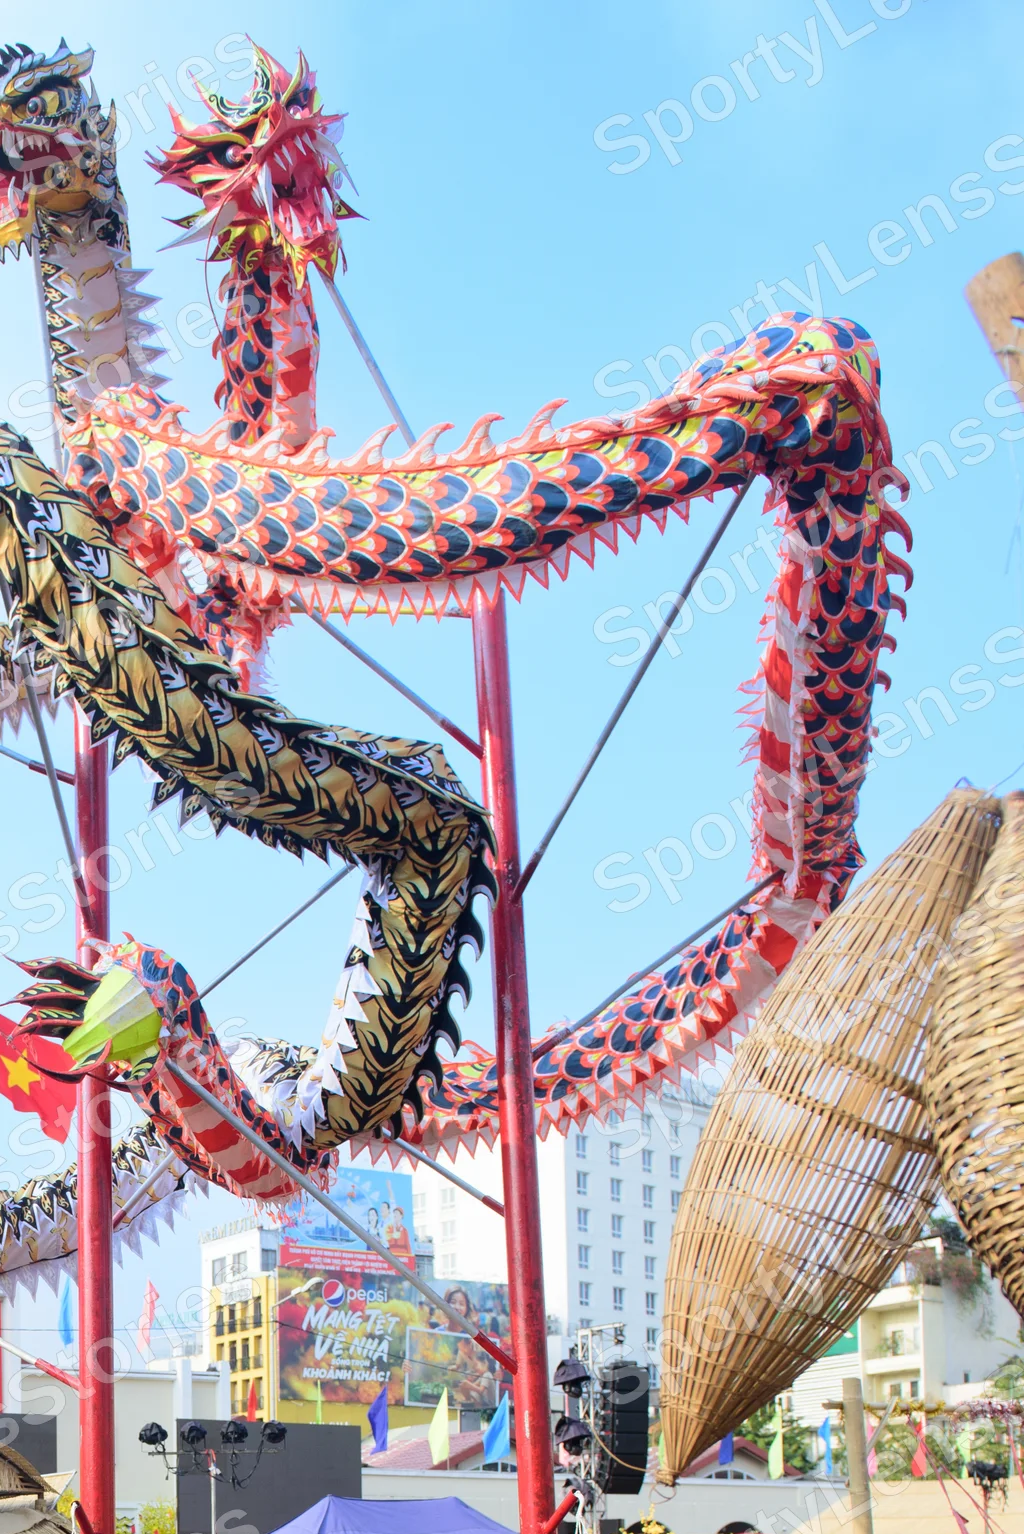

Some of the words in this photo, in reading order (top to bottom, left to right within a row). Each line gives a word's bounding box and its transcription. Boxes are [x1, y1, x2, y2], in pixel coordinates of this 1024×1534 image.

[347, 1288, 388, 1303] pepsi
[301, 1304, 363, 1332] MANG
[365, 1308, 401, 1336] TẾT
[314, 1329, 349, 1361] VỀ
[349, 1335, 394, 1363] NHÀ
[353, 1365, 391, 1382] KHẮC!
